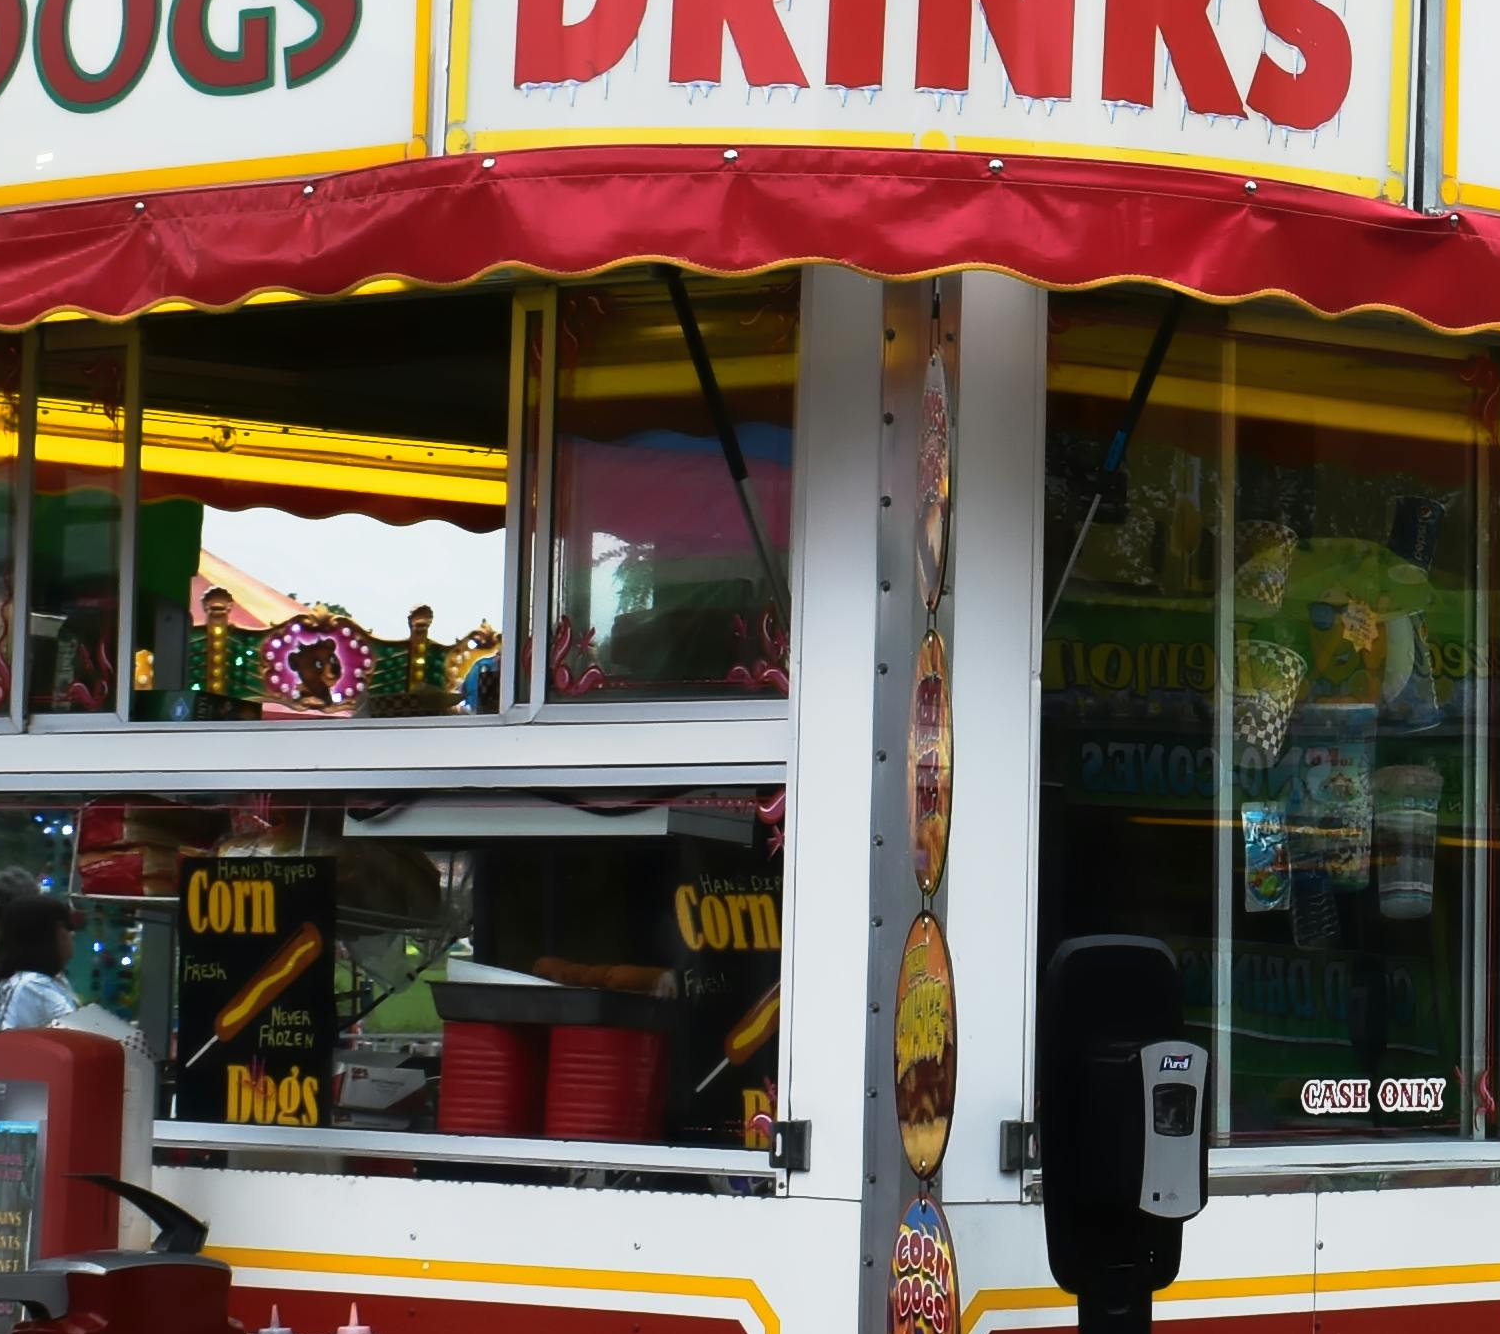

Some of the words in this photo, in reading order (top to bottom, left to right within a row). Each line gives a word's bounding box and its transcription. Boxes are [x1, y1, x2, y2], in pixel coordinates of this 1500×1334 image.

[187, 870, 277, 934] Corn
[674, 883, 783, 951] Corn
[259, 1024, 315, 1048] FROZEN
[271, 1006, 311, 1028] NEVER
[225, 1064, 319, 1127] Dogs
[1301, 1079, 1371, 1115] CASH
[1377, 1077, 1447, 1113] ONLY
[895, 1229, 951, 1295] CORN
[897, 1273, 945, 1334] DOGS
